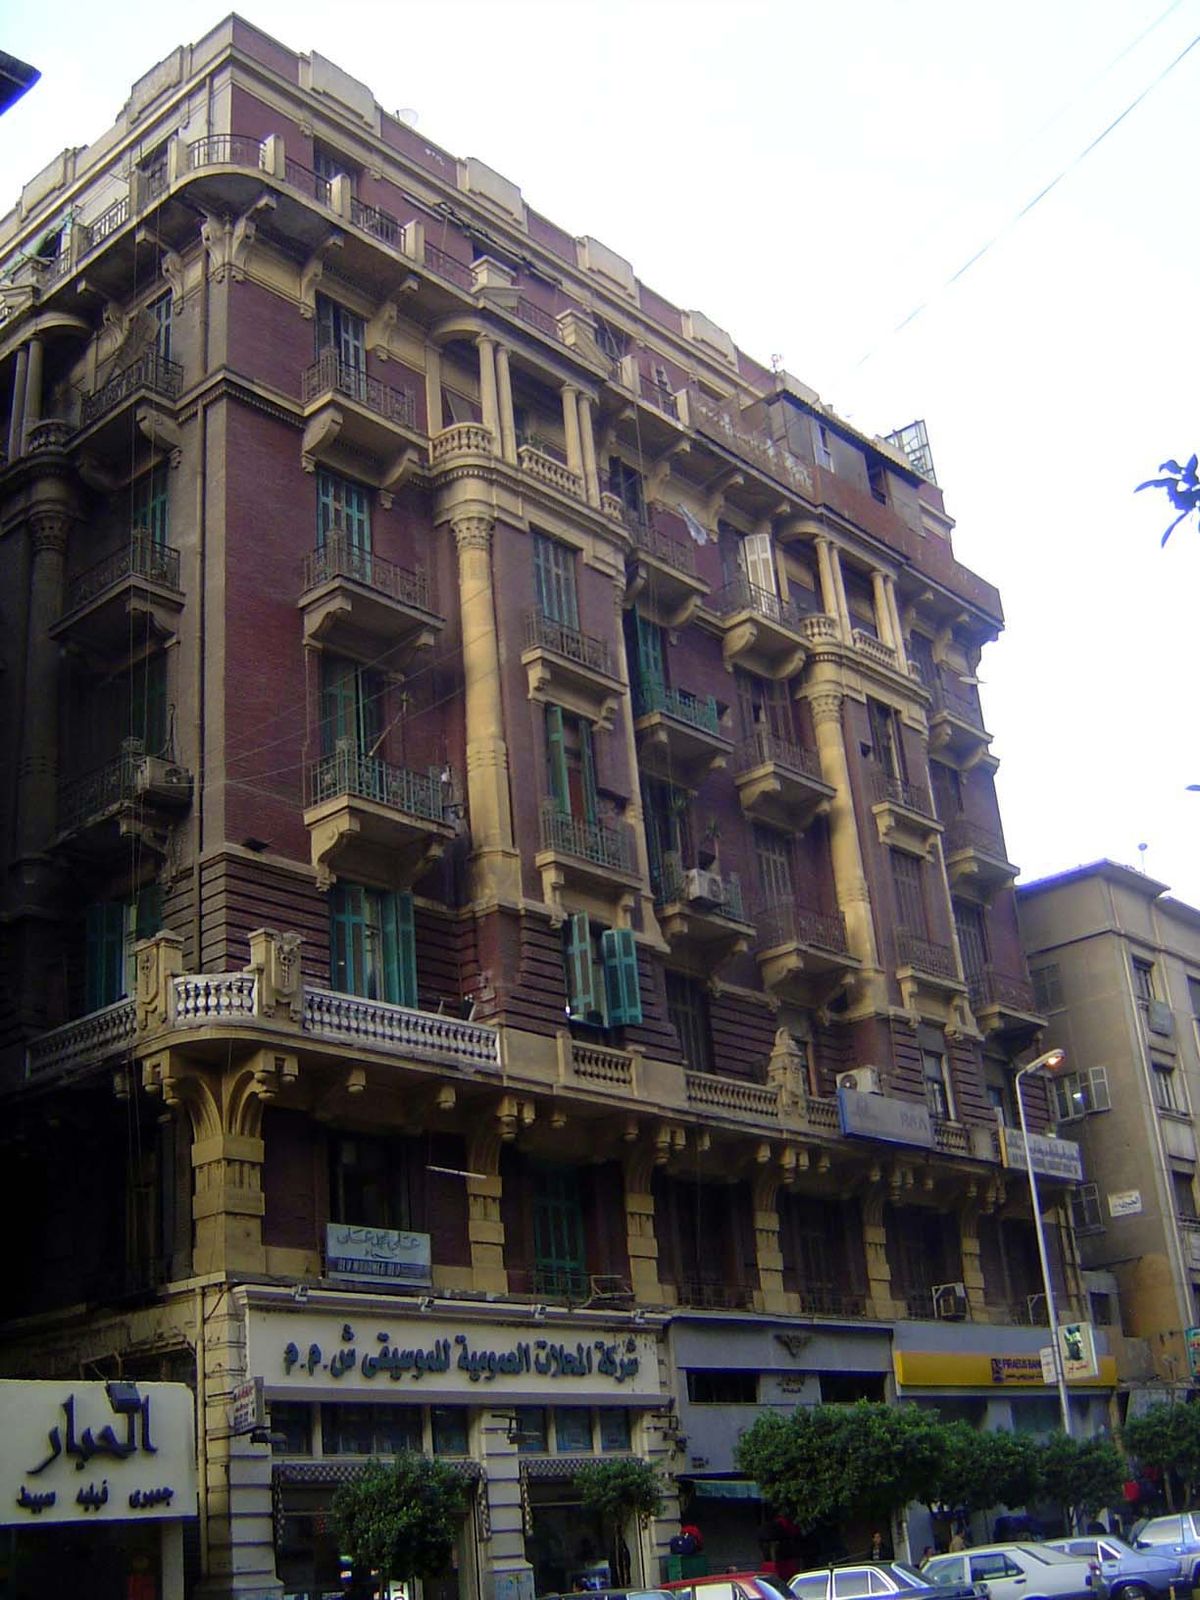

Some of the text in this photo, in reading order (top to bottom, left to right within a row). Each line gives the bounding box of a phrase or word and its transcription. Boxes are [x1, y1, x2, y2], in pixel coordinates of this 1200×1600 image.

[455, 1334, 531, 1383] العمومية
[534, 1340, 593, 1378] المحلات
[598, 1336, 639, 1383] شركة
